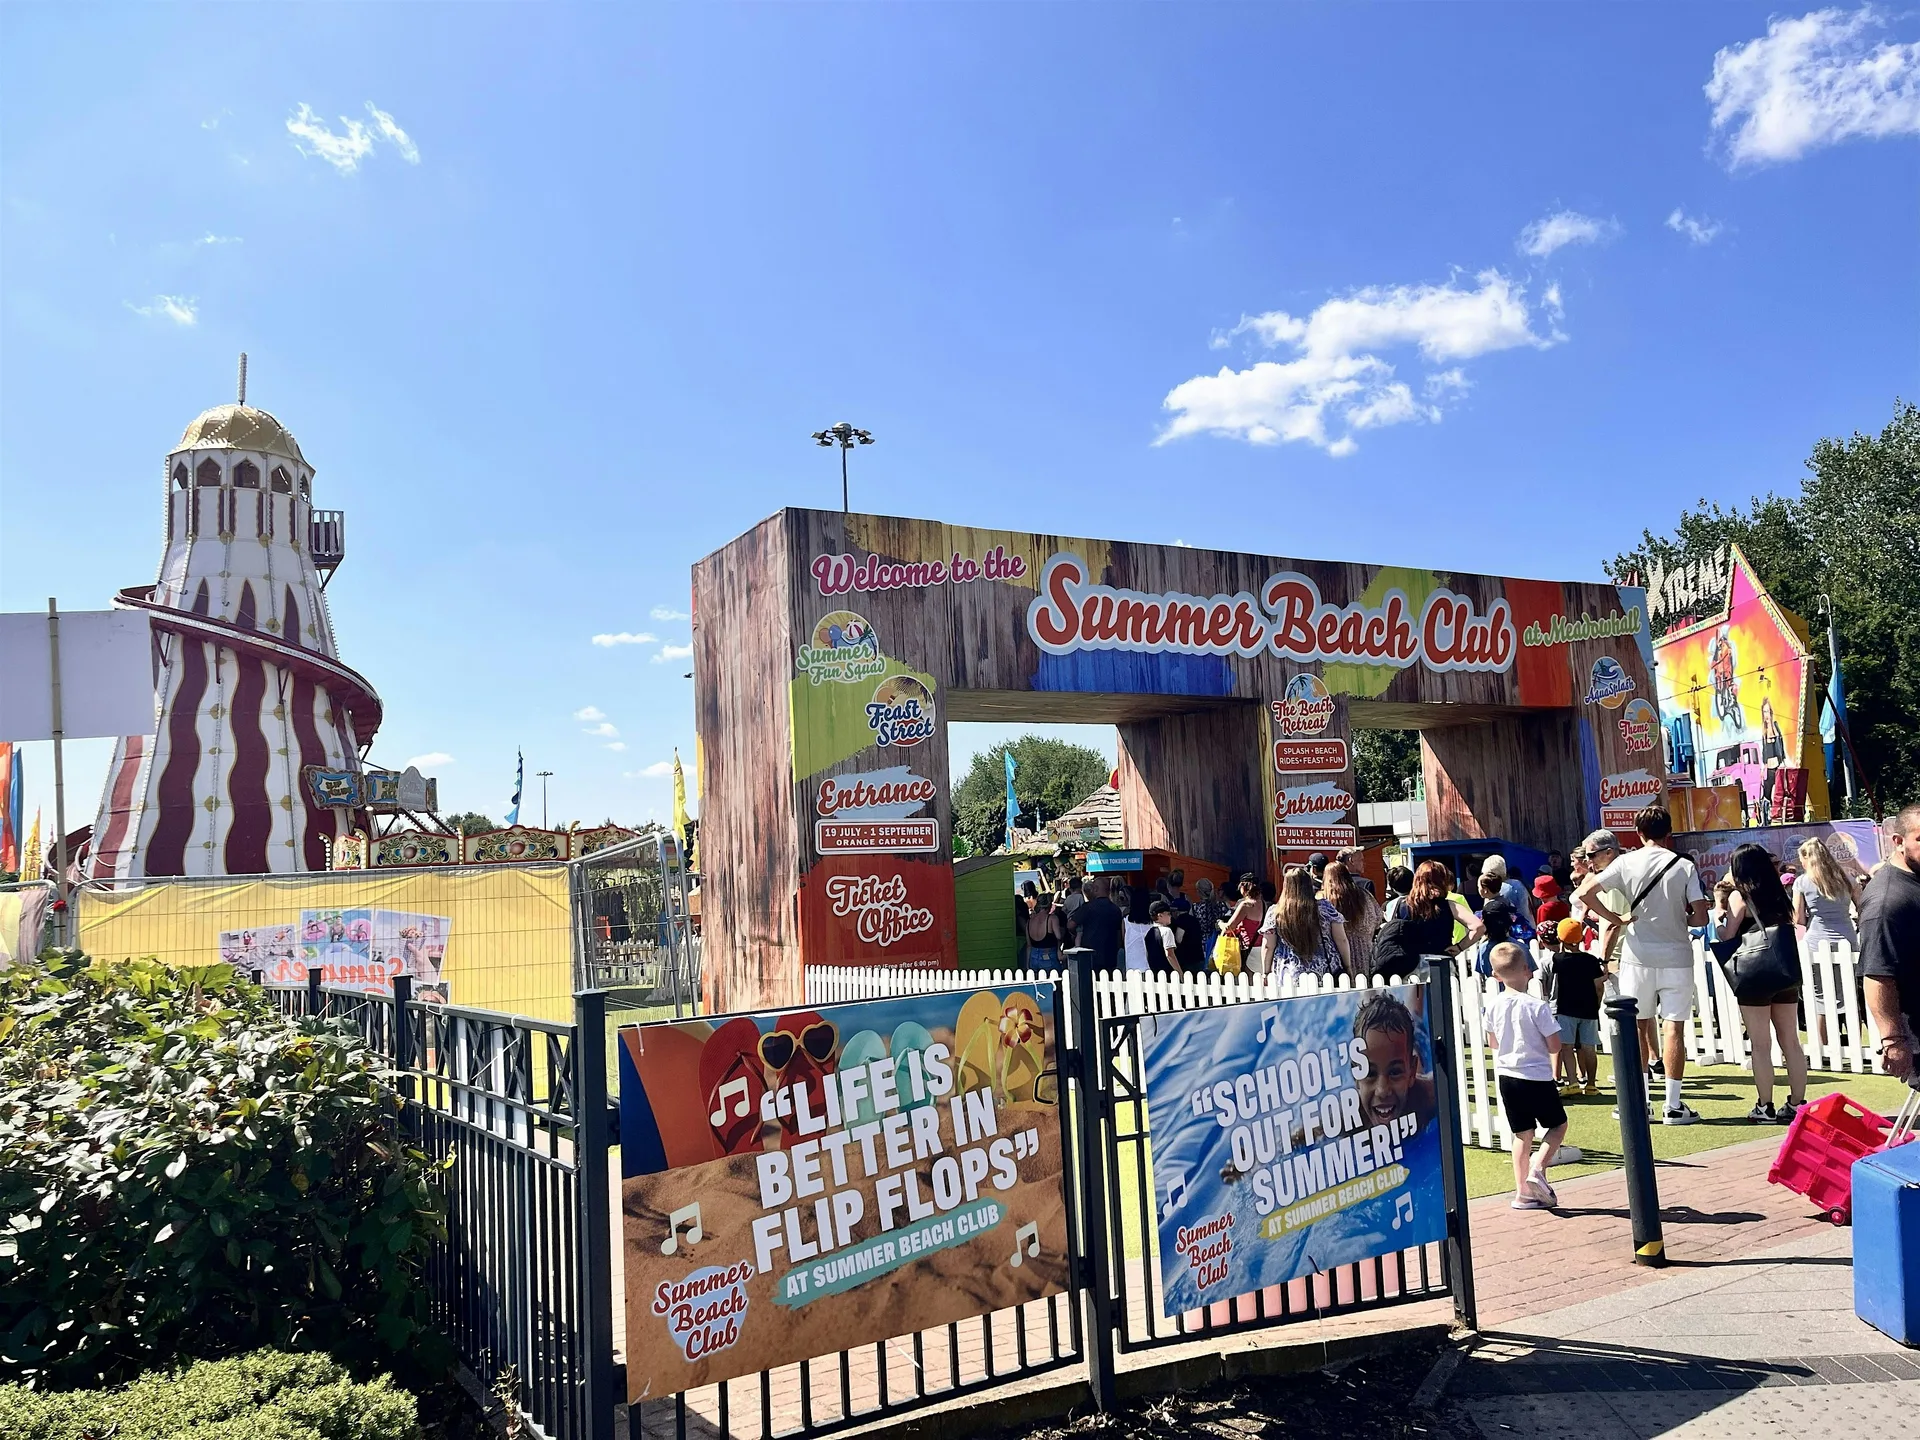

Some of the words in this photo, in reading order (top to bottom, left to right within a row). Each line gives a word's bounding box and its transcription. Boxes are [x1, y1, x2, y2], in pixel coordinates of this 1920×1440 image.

[812, 554, 948, 596] Welcome
[951, 552, 981, 582] to
[984, 545, 1027, 580] the
[1646, 544, 1727, 622] XTREME
[1036, 562, 1264, 648] Summer
[1268, 581, 1418, 658] Beach
[1423, 597, 1511, 668] Club
[1524, 621, 1543, 646] at
[1544, 606, 1641, 646] Meadowhall
[797, 644, 873, 669] Summer
[810, 666, 842, 685] Fun
[844, 657, 886, 680] Squad
[1585, 676, 1636, 704] AquaSplash
[866, 699, 921, 729] Feast
[1272, 700, 1297, 720] The
[1298, 697, 1335, 716] Beach
[1281, 715, 1326, 735] Retreat
[877, 718, 934, 746] Street
[1619, 720, 1649, 738] Theme
[1626, 734, 1651, 755] Park
[1283, 747, 1309, 755] SPLASH
[1303, 756, 1324, 764] FEAST
[817, 780, 936, 816] Entrance
[1275, 791, 1354, 820] Entrance
[1600, 777, 1662, 805] Entrance
[825, 828, 837, 837] 19
[839, 828, 861, 837] JULY
[870, 827, 876, 836] 1
[879, 826, 931, 836] SEPTEMBER
[836, 838, 875, 846] ORANGE
[879, 838, 897, 846] CAR
[900, 837, 925, 845] PARK
[1279, 829, 1287, 837] 19
[1289, 829, 1303, 837] JULY
[1316, 830, 1353, 838] SEPTEMBER
[827, 875, 906, 915] Ticket
[858, 905, 933, 945] Office
[908, 1044, 953, 1101] IS
[756, 1106, 942, 1208] BETTER
[951, 1086, 998, 1146] IN
[1231, 1109, 1294, 1172] OUT
[1300, 1088, 1362, 1147] FOR
[1268, 1219, 1282, 1237] AT
[1285, 1198, 1337, 1229] SUMMER
[1338, 1181, 1375, 1207] BEACH
[1376, 1167, 1405, 1194] CLUB
[752, 1190, 865, 1274] FLIP
[1176, 1212, 1235, 1253] Summer
[1187, 1232, 1232, 1268] Beach
[786, 1272, 812, 1299] AT
[814, 1246, 896, 1288] SUMMER
[898, 1222, 956, 1258] BEACH
[957, 1204, 999, 1239] CLUB
[653, 1261, 753, 1314] Summer
[1197, 1260, 1228, 1290] Club
[671, 1286, 747, 1333] Beach
[685, 1317, 738, 1360] Club
